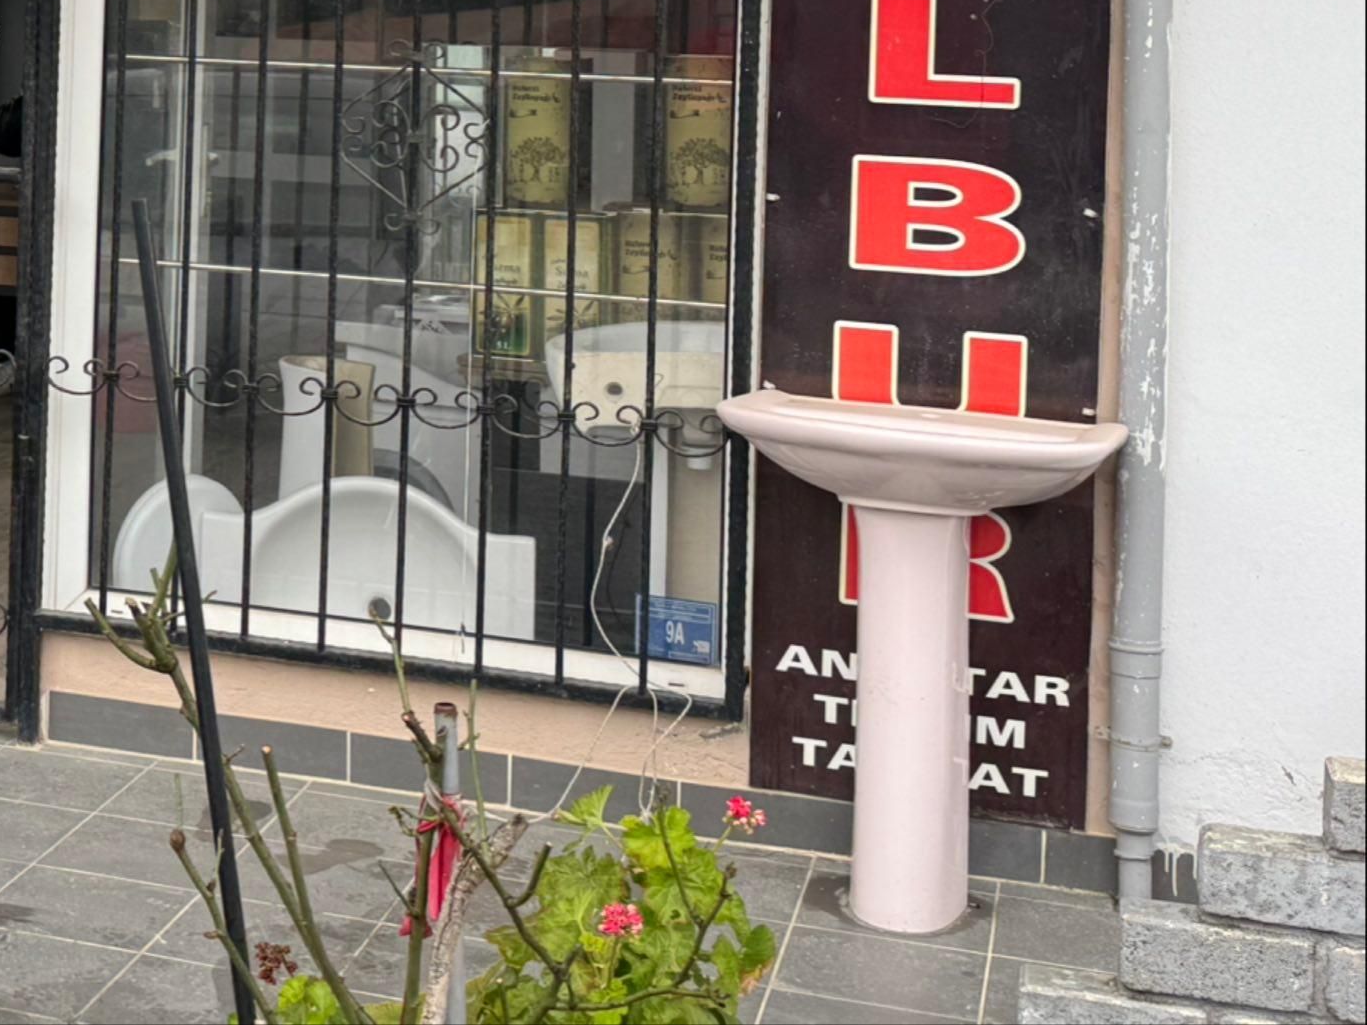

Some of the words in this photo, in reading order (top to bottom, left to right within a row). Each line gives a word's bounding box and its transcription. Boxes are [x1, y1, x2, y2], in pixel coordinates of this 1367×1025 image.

[665, 620, 685, 645] 9A
[776, 644, 1070, 707] ANTAR
[792, 736, 1049, 798] TAAT
